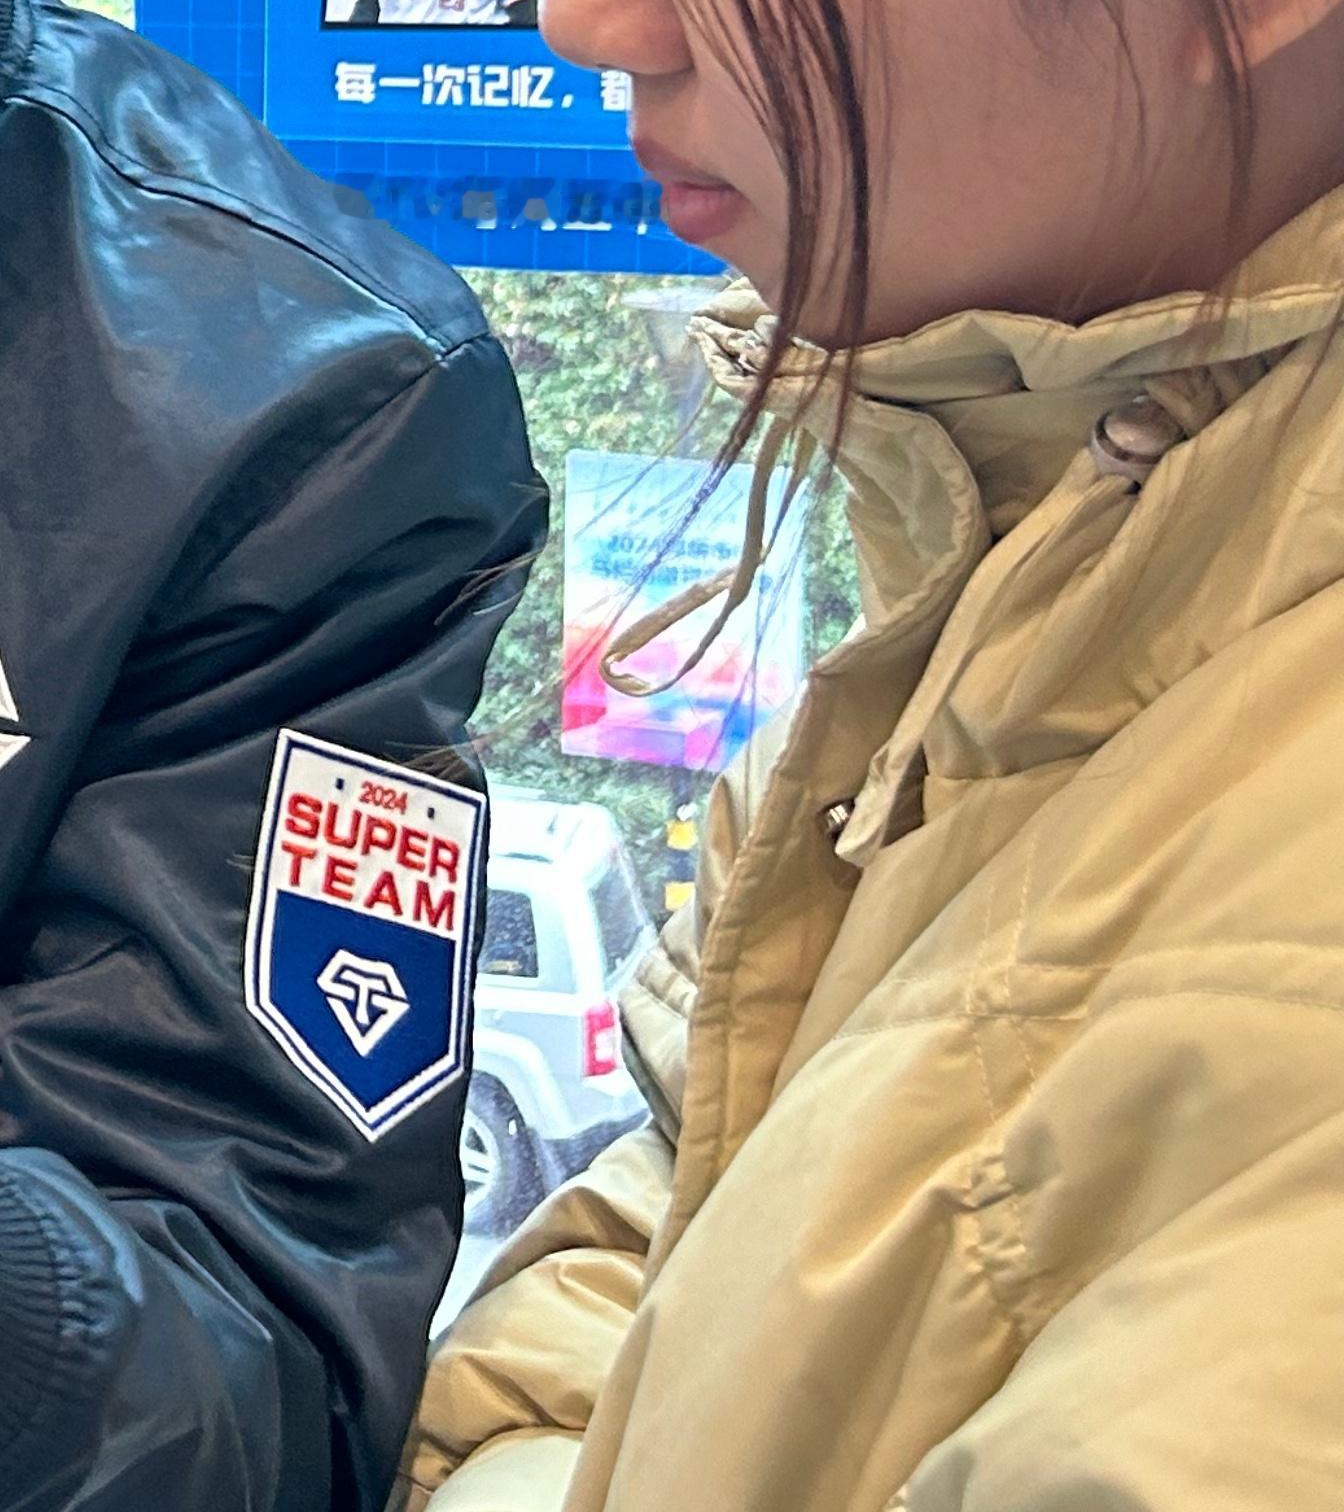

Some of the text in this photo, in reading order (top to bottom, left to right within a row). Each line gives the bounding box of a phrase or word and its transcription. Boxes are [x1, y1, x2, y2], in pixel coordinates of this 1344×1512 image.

[285, 791, 460, 884] SUPER
[358, 781, 409, 816] 2024
[281, 842, 455, 932] TEAM
